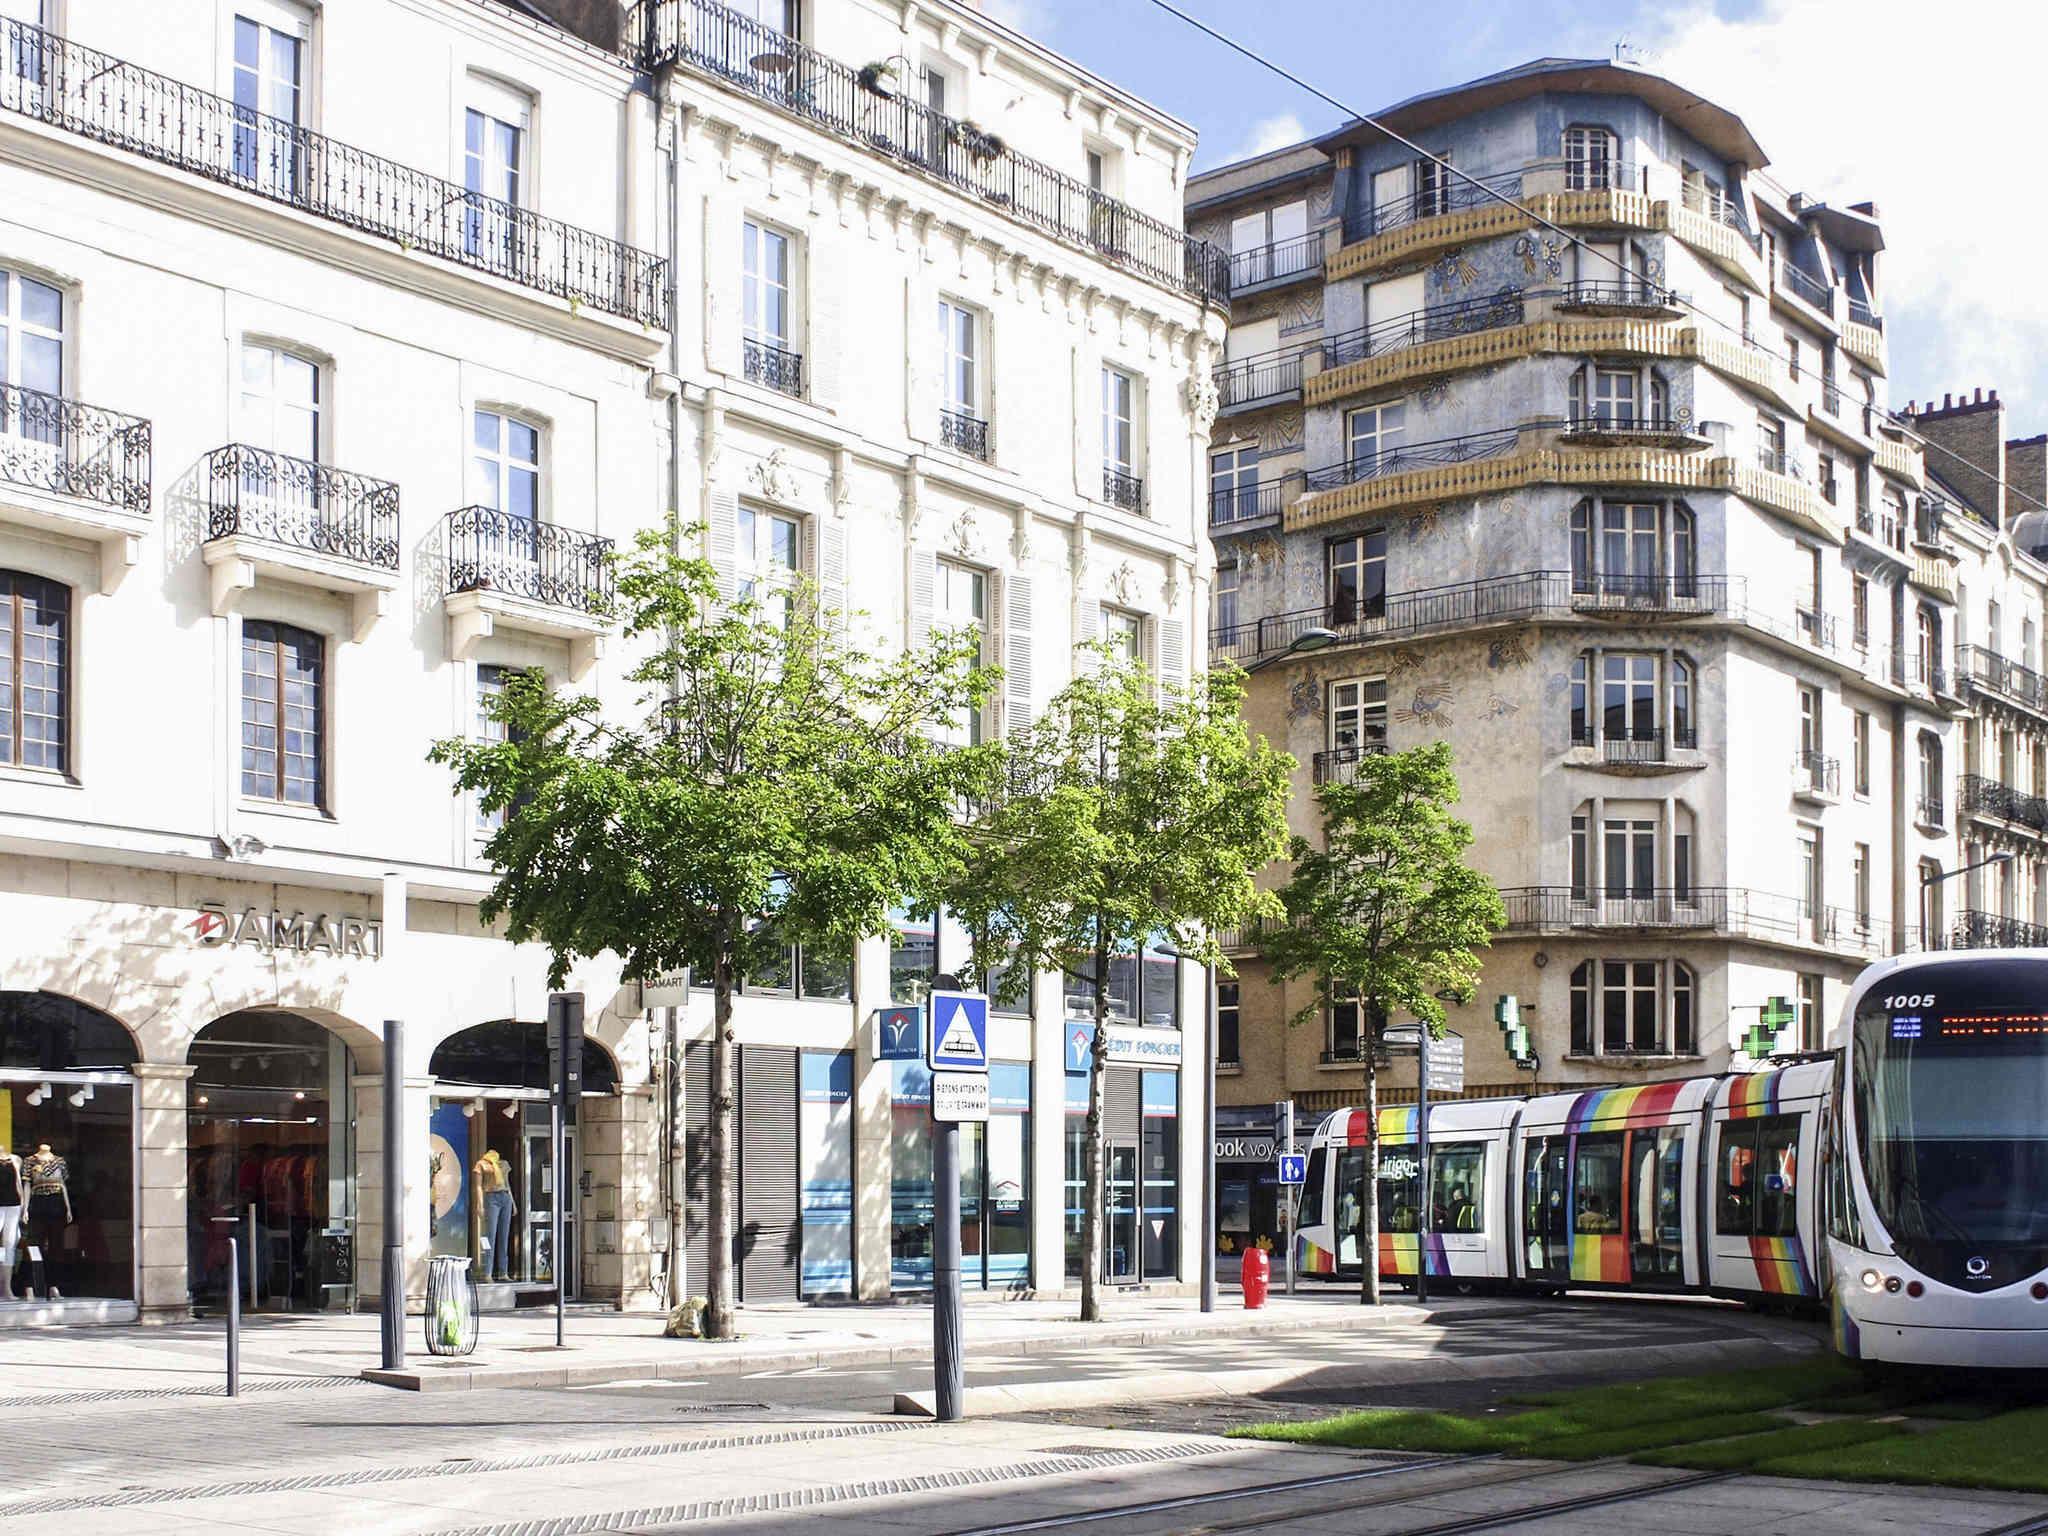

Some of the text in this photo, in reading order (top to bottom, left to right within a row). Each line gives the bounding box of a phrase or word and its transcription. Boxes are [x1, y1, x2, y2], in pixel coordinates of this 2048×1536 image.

[185, 904, 383, 960] DAMART
[1884, 994, 1936, 1009] 1005
[1214, 1138, 1245, 1157] ook
